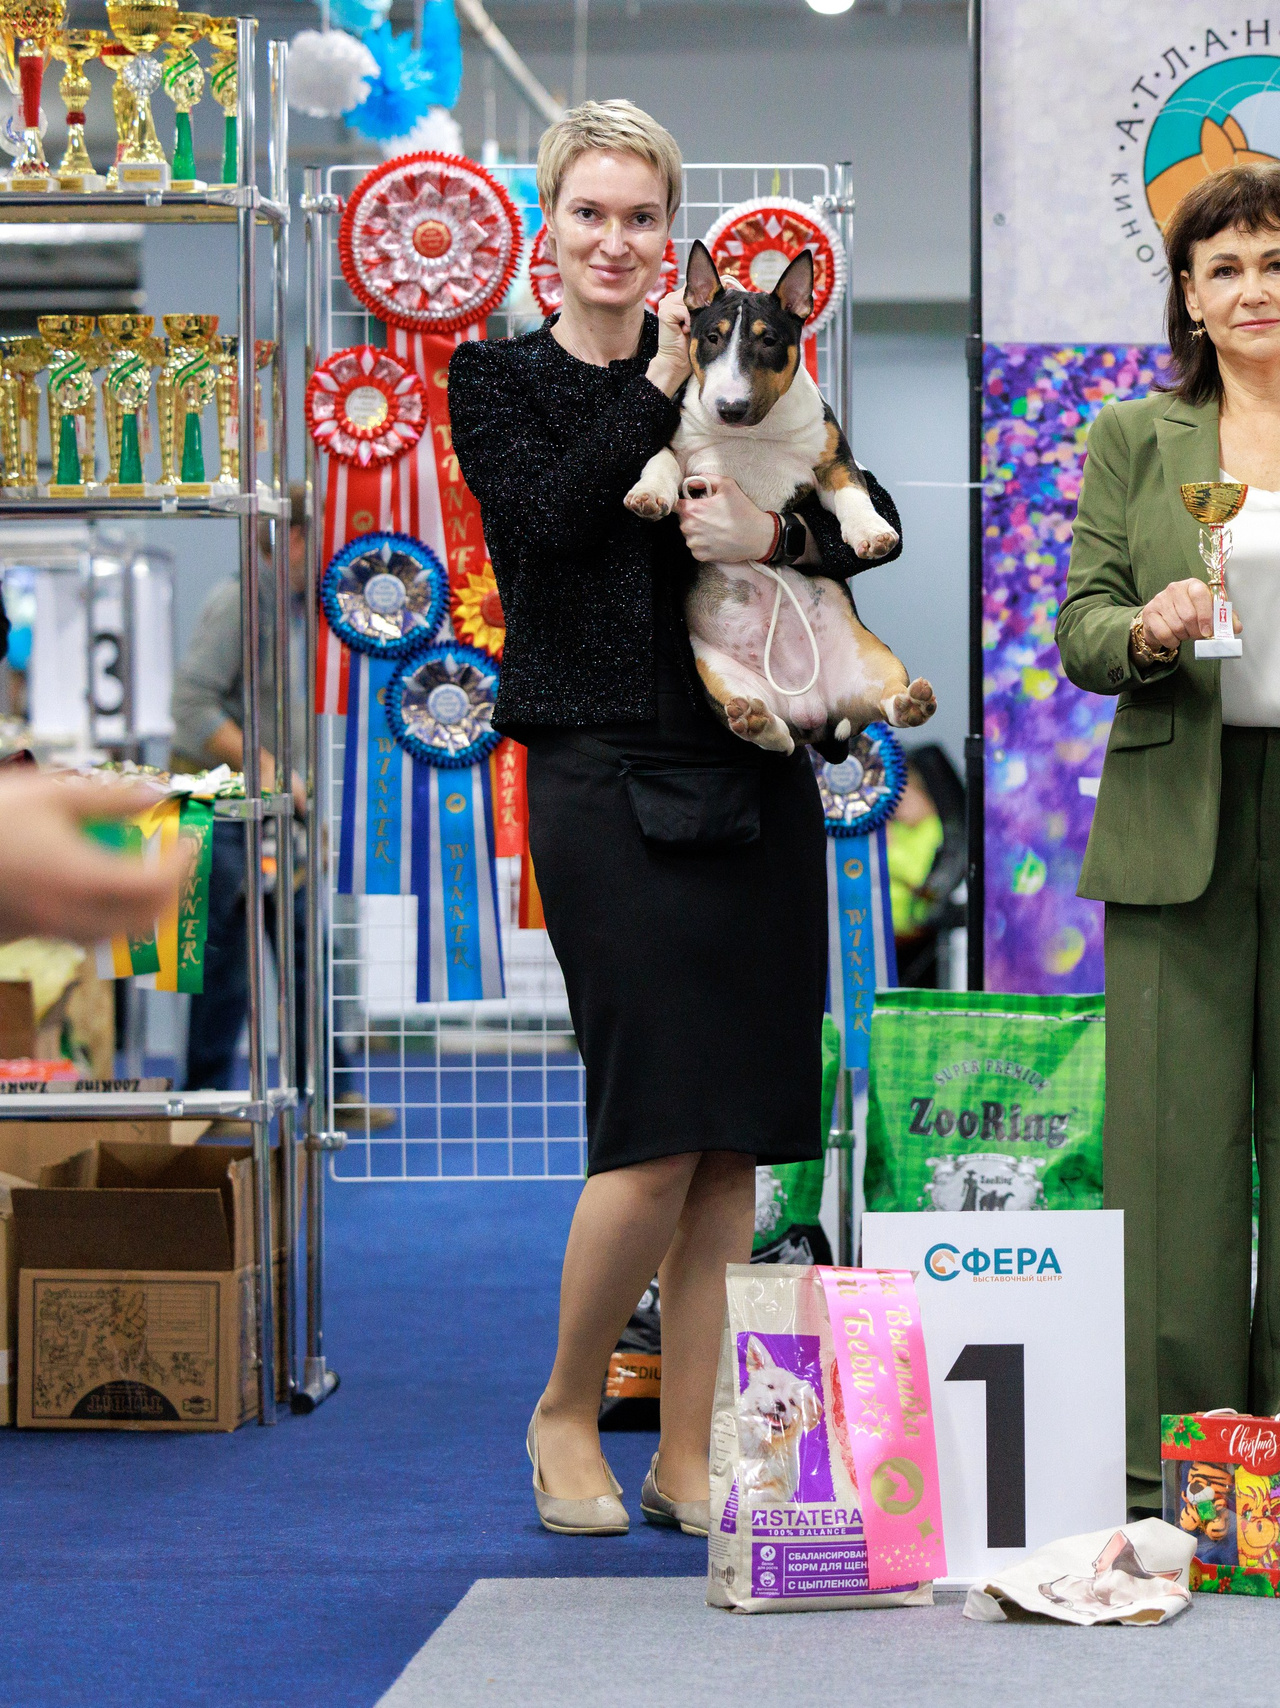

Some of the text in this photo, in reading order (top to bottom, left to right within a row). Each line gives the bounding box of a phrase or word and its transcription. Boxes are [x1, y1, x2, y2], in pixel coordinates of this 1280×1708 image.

[94, 632, 123, 715] 3
[446, 843, 475, 971] WINNER
[844, 909, 871, 1035] WINNER
[933, 1058, 1051, 1092] SUPER PREMIUM
[909, 1097, 1069, 1149] ZooRing
[924, 1243, 1063, 1281] СФЕРА
[973, 1274, 1063, 1283] ВЫСТАВОЧНЫЙ ЦЕНТР
[843, 1308, 888, 1394] Беби
[886, 1304, 928, 1443] Выставка
[944, 1343, 1026, 1548] 1
[770, 1510, 863, 1527] STATERA
[799, 1527, 847, 1536] BALANCE
[788, 1550, 867, 1561] СБАЛАНСИРОВАН
[788, 1561, 867, 1572] КОРМ ДЛЯ ЩЕН
[788, 1578, 869, 1591] С ЦЫПЛЕНКОМ
